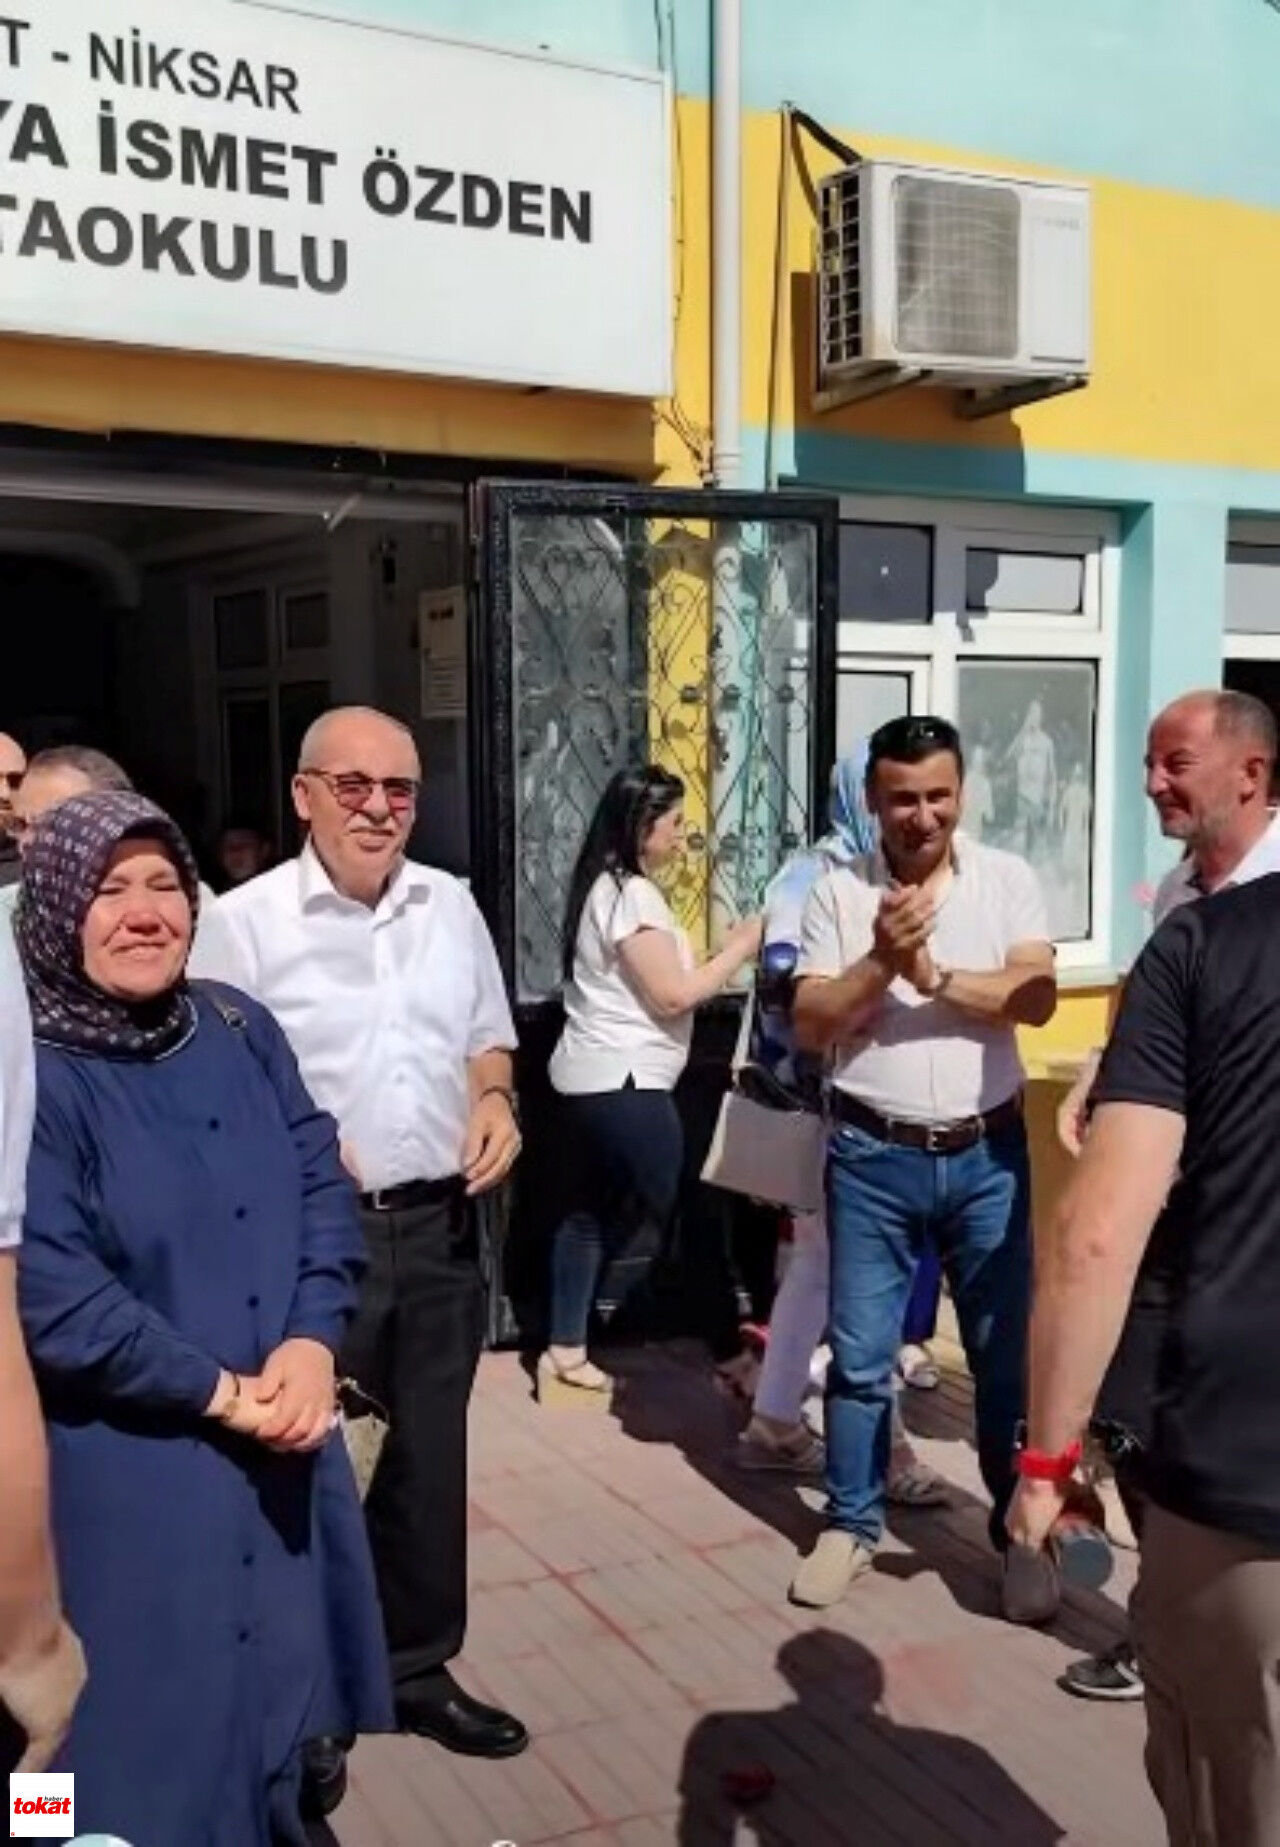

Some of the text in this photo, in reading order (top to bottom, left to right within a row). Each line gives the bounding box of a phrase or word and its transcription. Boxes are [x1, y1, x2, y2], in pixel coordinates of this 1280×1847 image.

[89, 27, 300, 114] NİKSAR
[0, 99, 592, 244] A İSMET ÖZDEN
